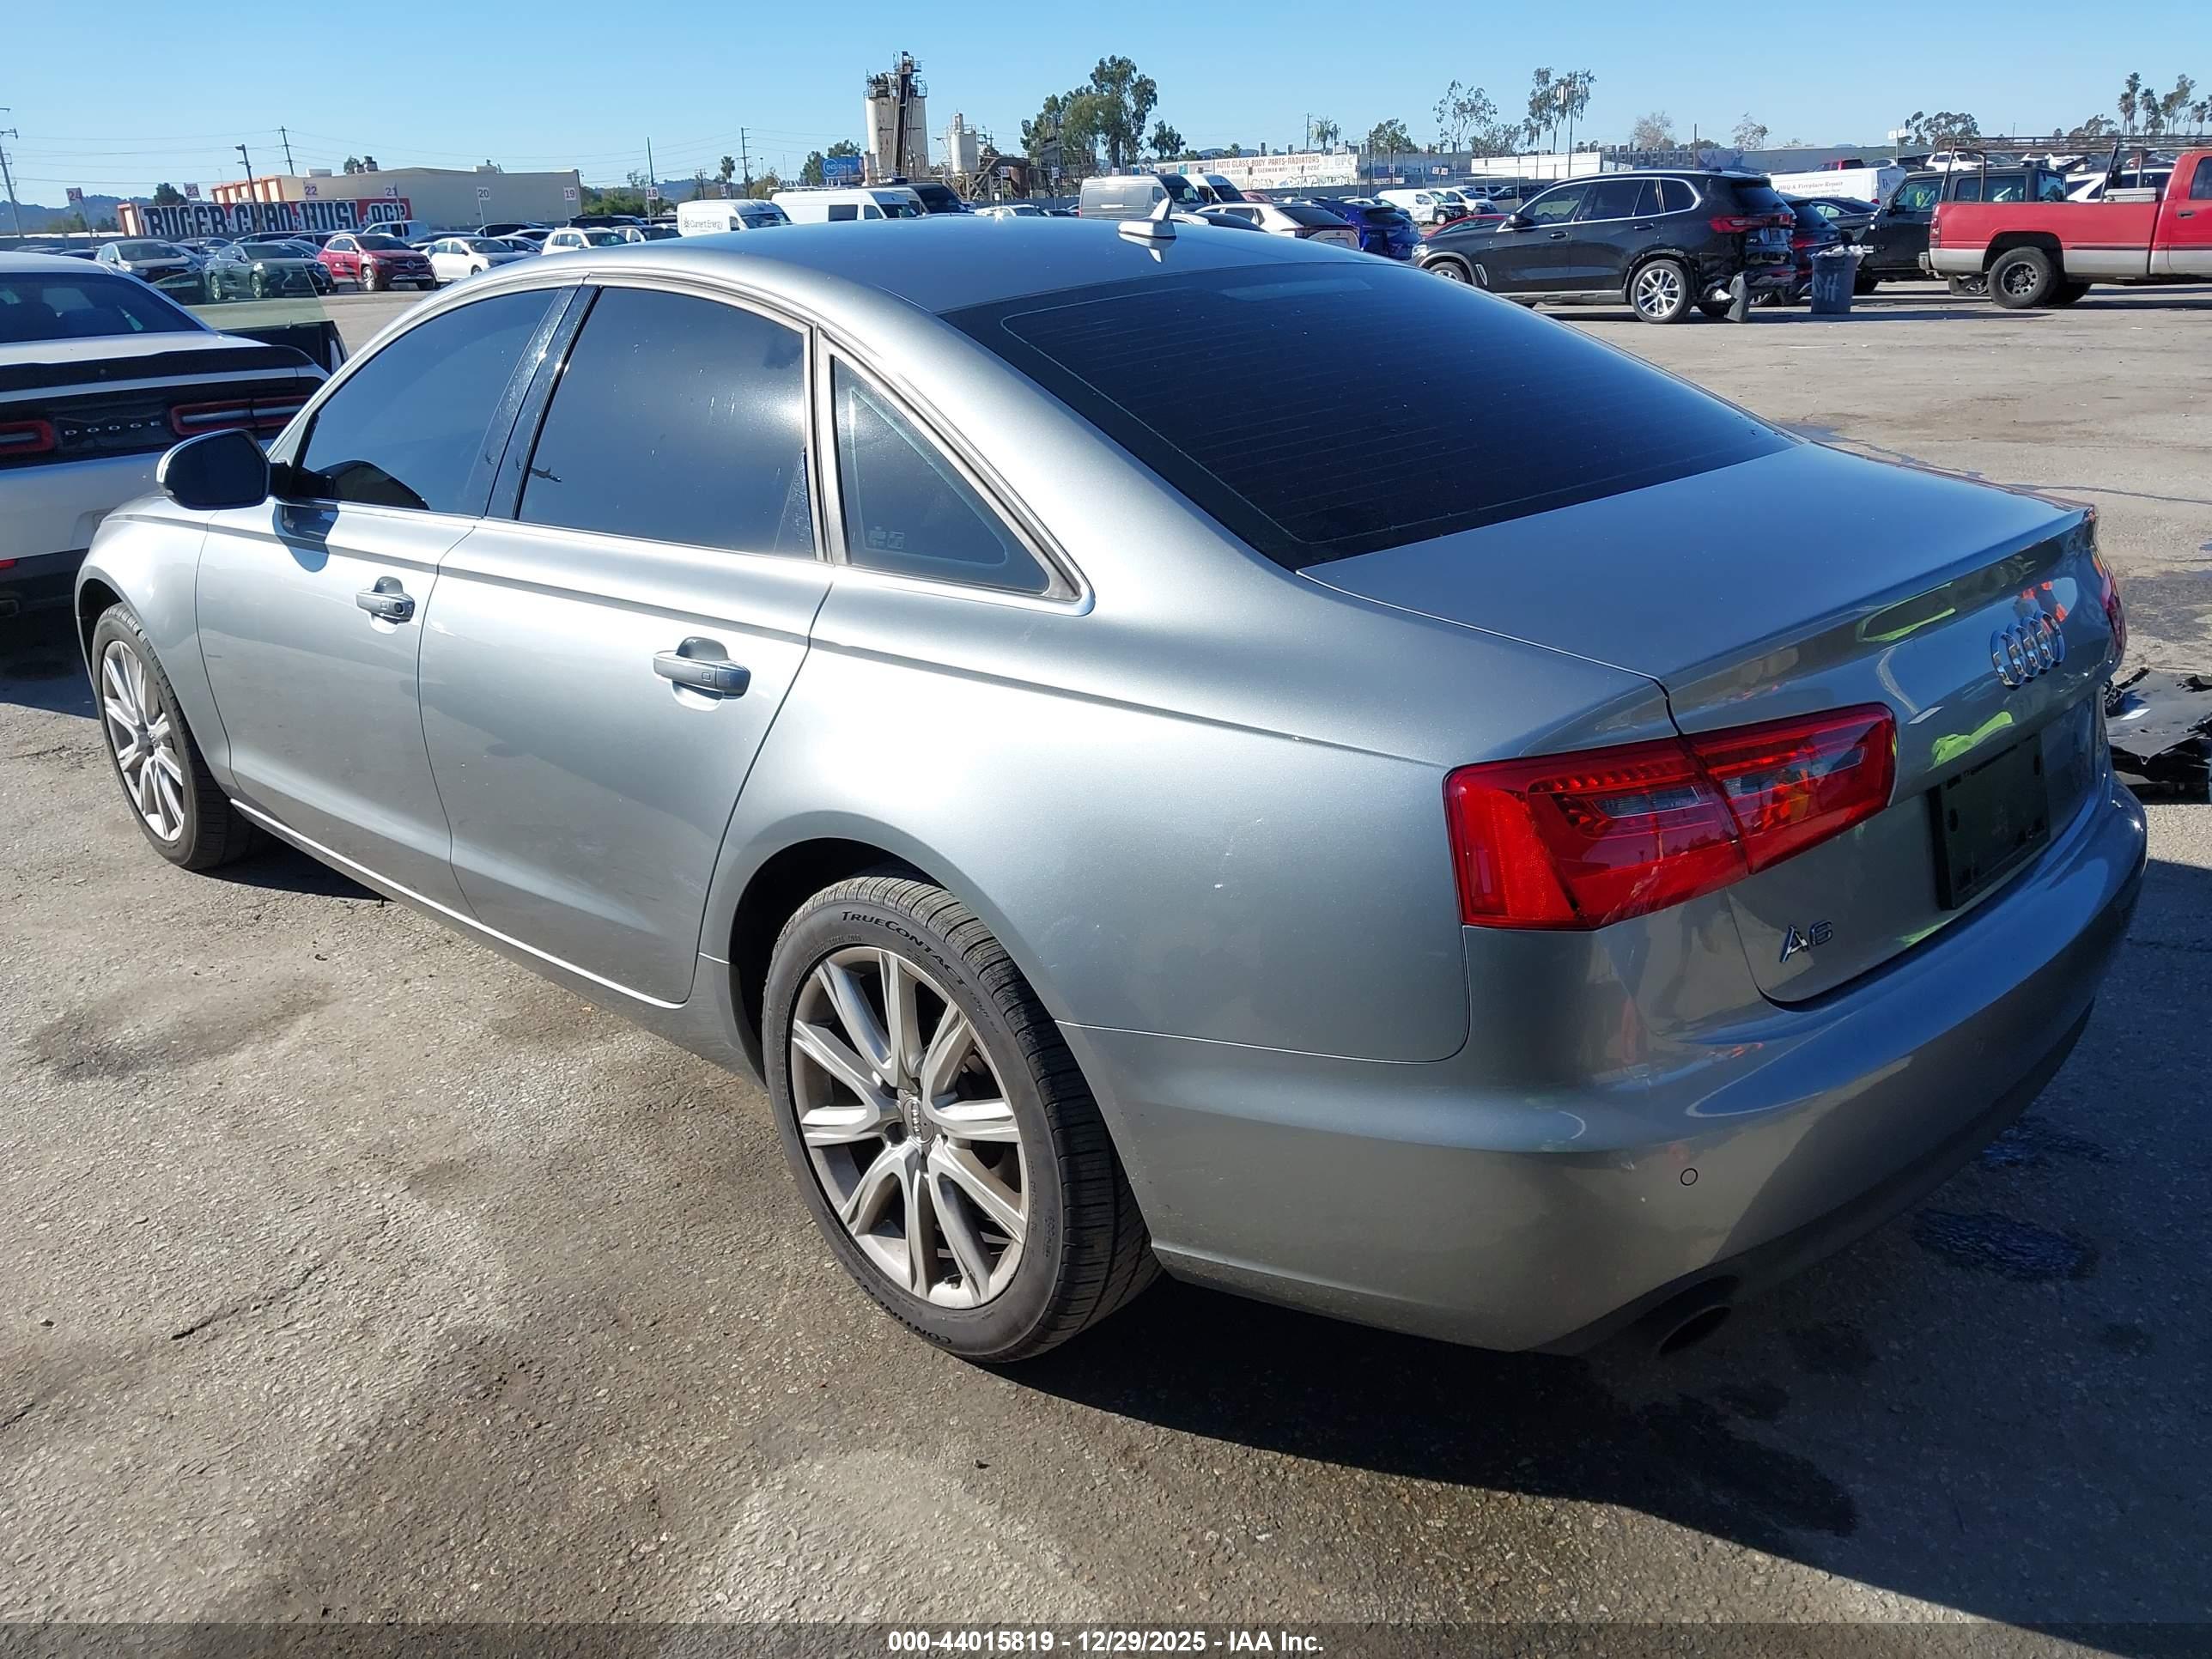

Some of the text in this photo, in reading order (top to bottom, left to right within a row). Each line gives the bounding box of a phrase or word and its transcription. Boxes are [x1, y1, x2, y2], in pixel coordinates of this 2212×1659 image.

[1232, 159, 1249, 168] GLASS
[1251, 158, 1266, 167] BODY
[68, 190, 82, 201] 24
[185, 185, 199, 197] 23
[306, 186, 319, 198] 22
[477, 188, 489, 198] 20
[565, 188, 575, 198] 19
[647, 187, 658, 198] 18
[707, 218, 724, 230] Energy
[64, 420, 161, 436] DODGE
[1779, 919, 1833, 963] A6
